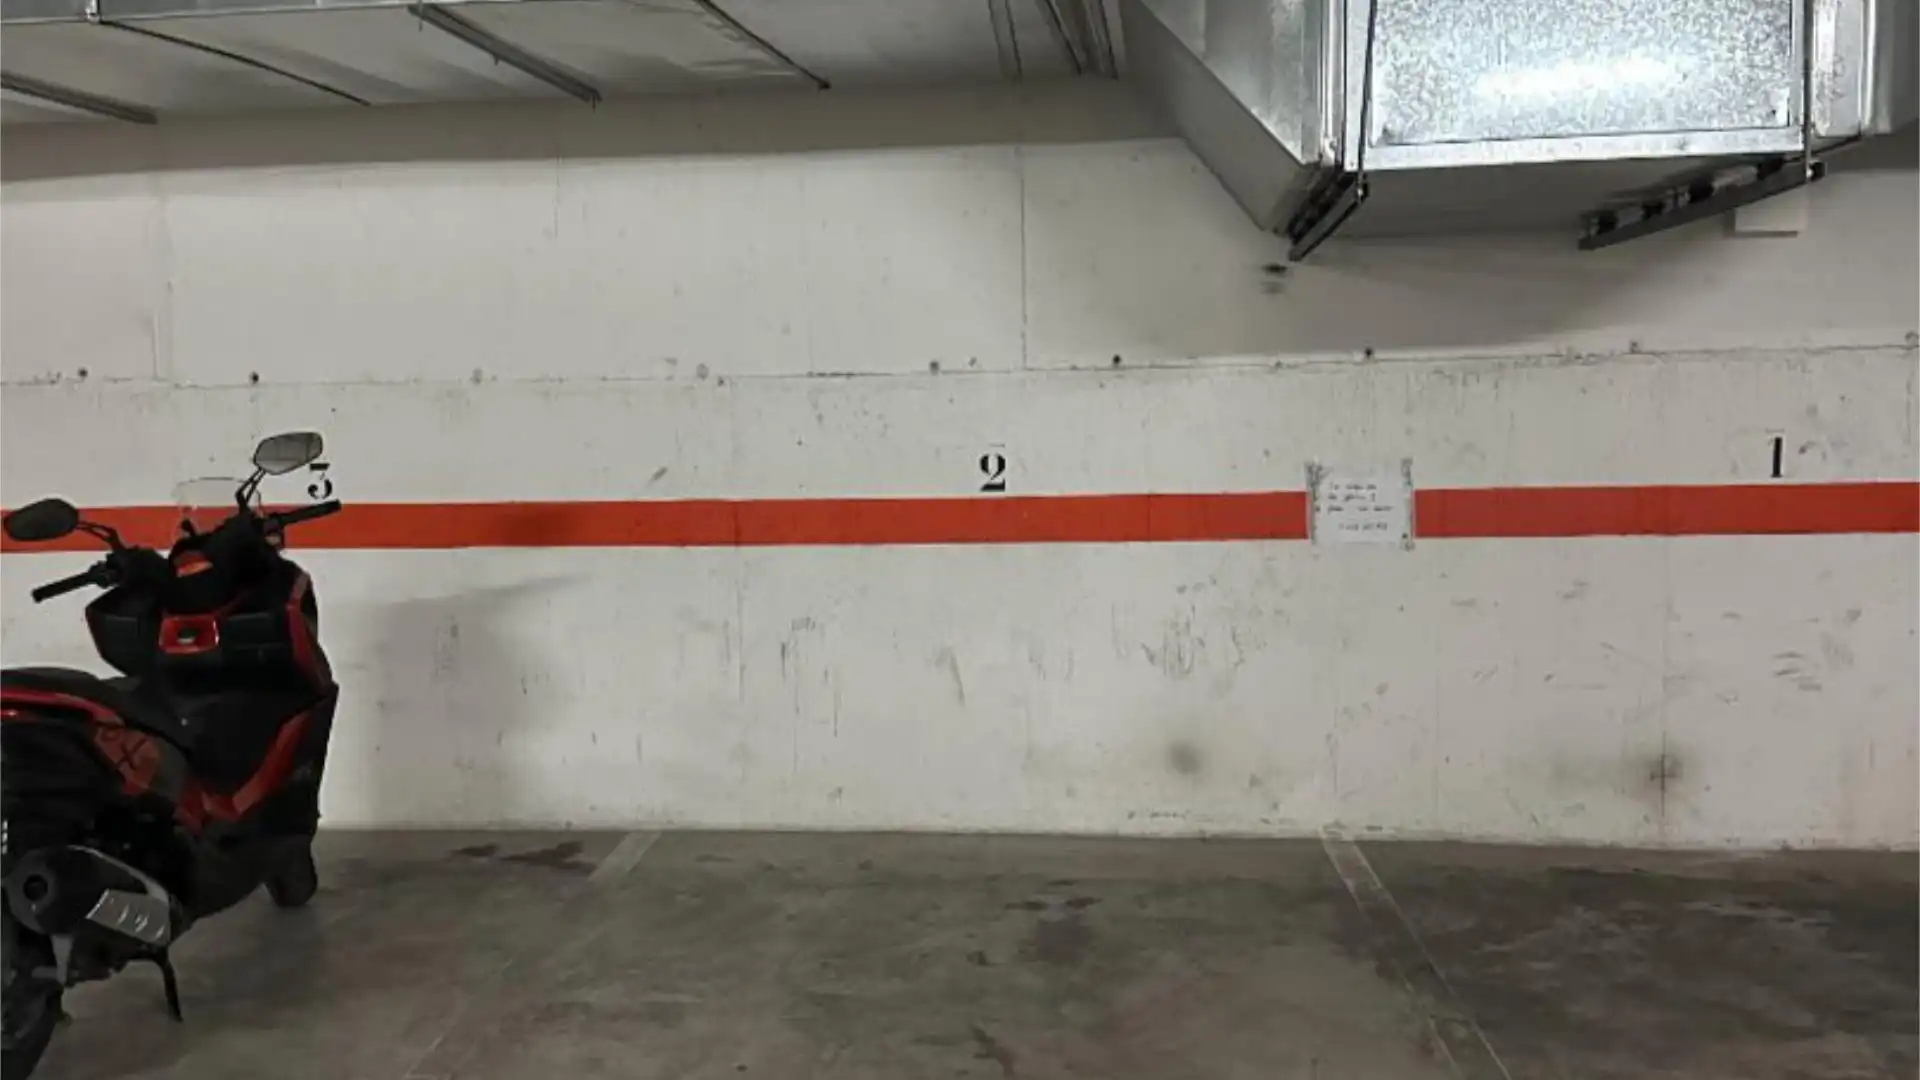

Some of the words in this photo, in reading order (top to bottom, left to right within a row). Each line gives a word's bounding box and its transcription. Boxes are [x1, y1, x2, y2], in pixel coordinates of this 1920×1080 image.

[980, 453, 1005, 492] 2
[1769, 436, 1783, 479] 1
[308, 463, 332, 500] 3
